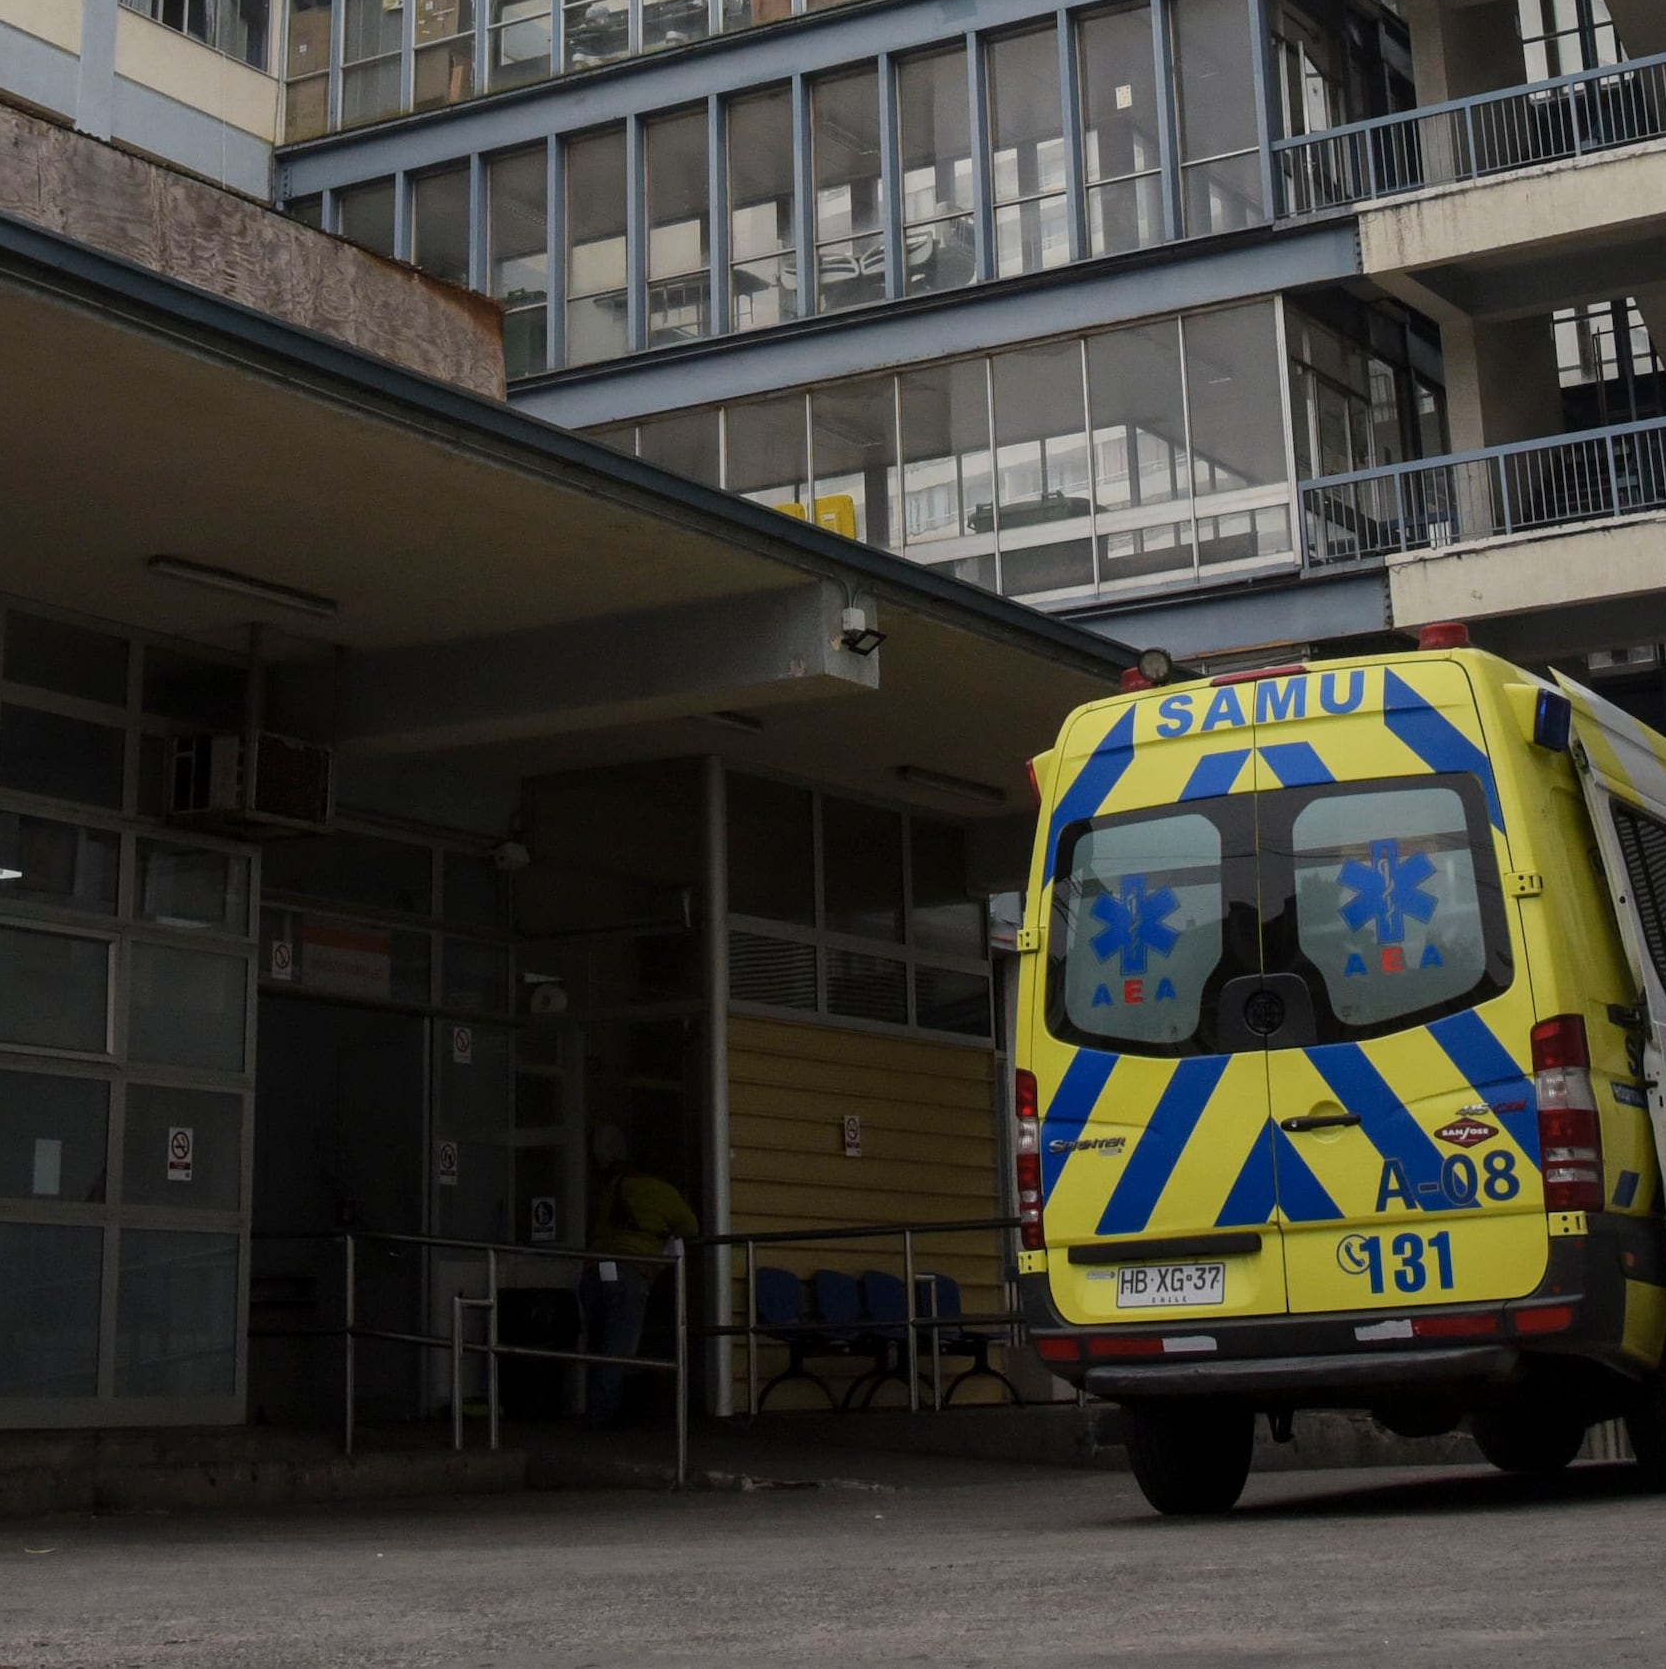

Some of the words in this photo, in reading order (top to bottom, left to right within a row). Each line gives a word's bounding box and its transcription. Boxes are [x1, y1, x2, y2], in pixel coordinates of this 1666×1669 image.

[1156, 670, 1365, 738] SAMU
[1375, 1150, 1520, 1212] A-08
[1359, 1231, 1454, 1294] 131
